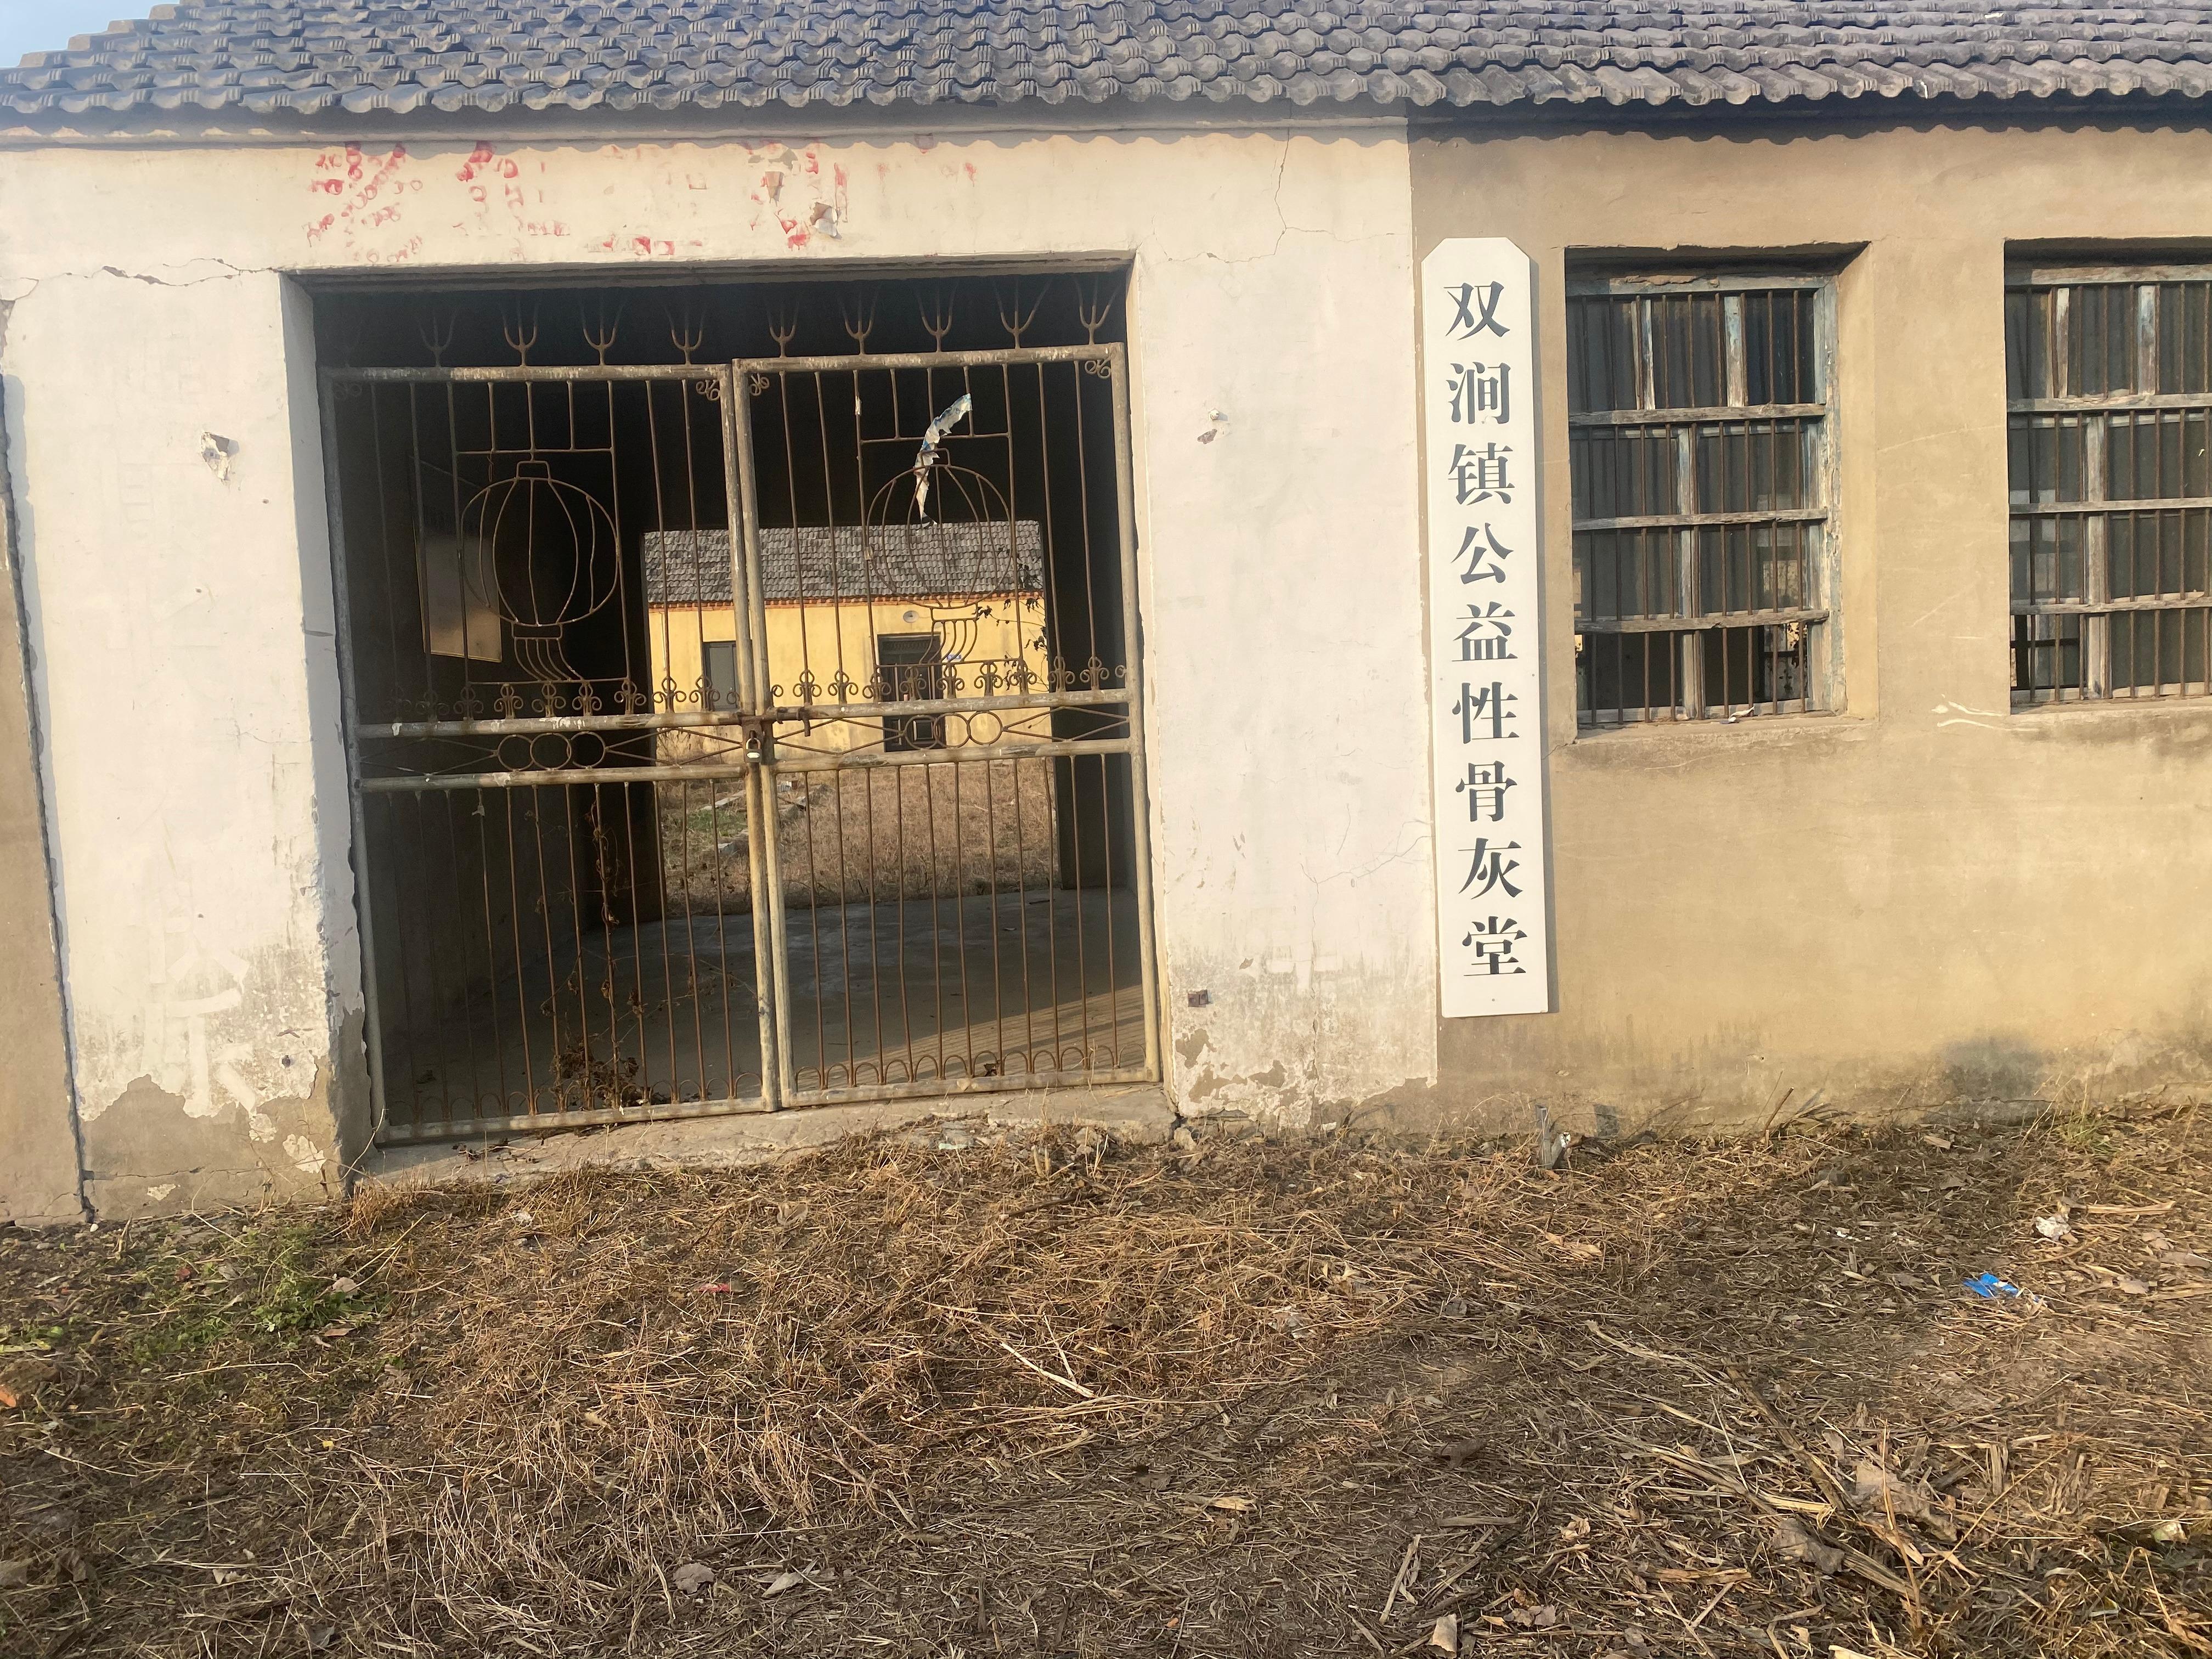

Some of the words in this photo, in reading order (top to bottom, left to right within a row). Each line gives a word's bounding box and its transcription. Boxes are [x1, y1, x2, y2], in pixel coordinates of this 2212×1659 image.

[1444, 280, 1528, 977] 双涧镇公益性骨灰堂
